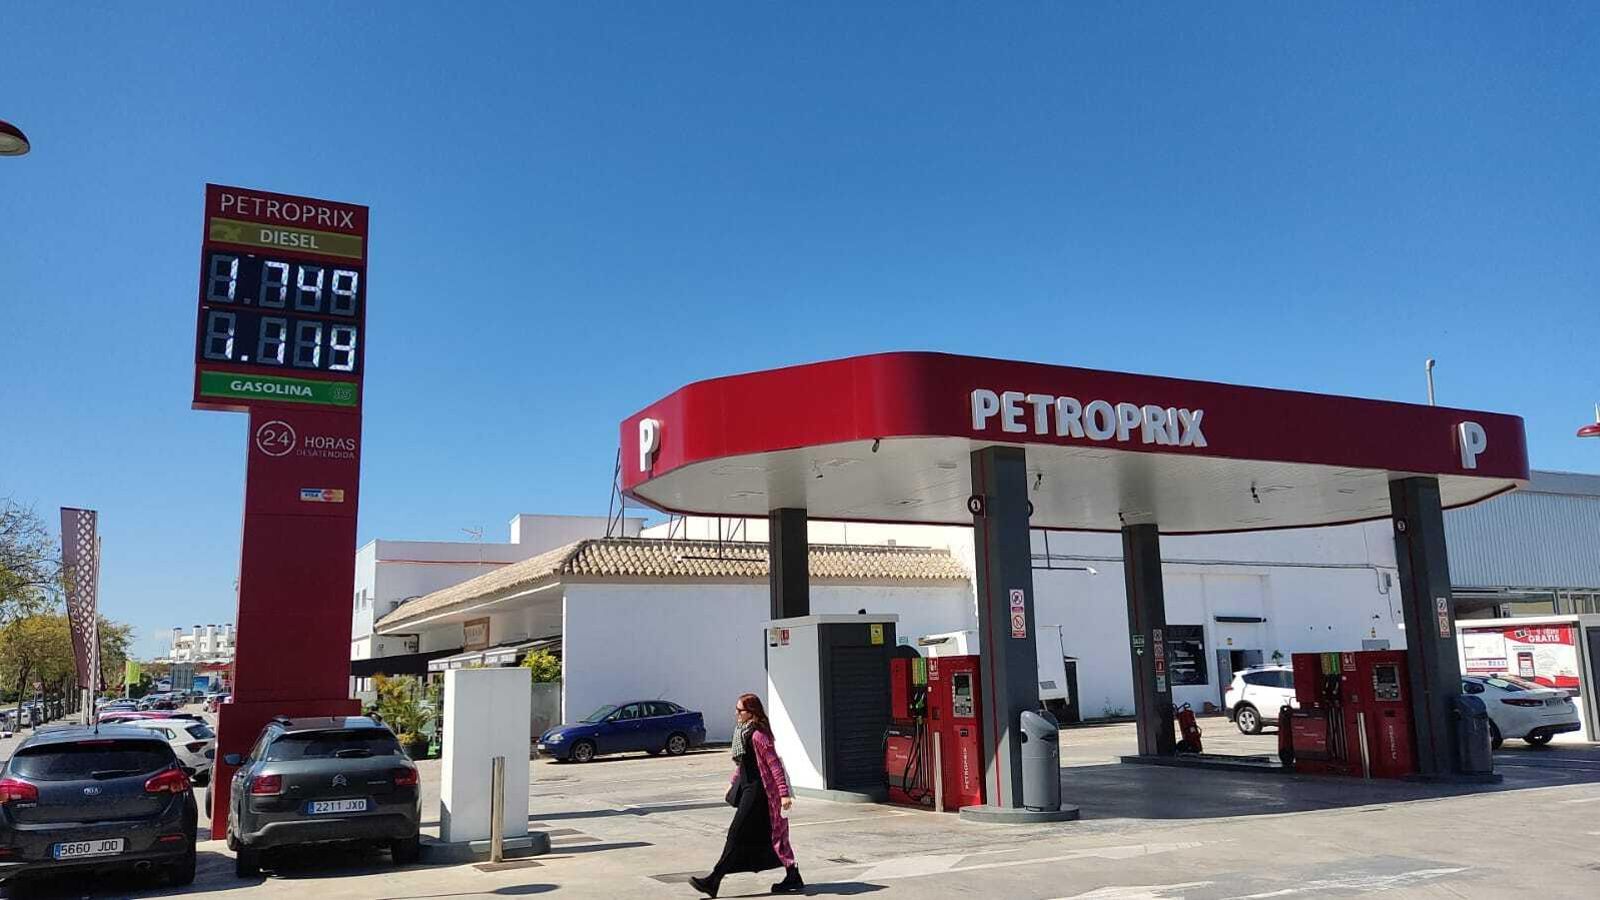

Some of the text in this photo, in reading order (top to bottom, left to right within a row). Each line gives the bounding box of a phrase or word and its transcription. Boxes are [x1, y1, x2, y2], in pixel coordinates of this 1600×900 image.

[220, 193, 355, 229] PETROPRIX
[259, 229, 320, 249] DIESEL
[230, 380, 313, 397] GASOLINA
[970, 388, 1208, 448] PETROPRIX
[262, 429, 356, 451] 24 HORAS
[638, 417, 661, 472] P
[1458, 421, 1487, 469] P
[296, 448, 355, 460] DESATENDIDA
[316, 800, 365, 812] 2211 JXD
[61, 840, 118, 855] 5660 JDD
